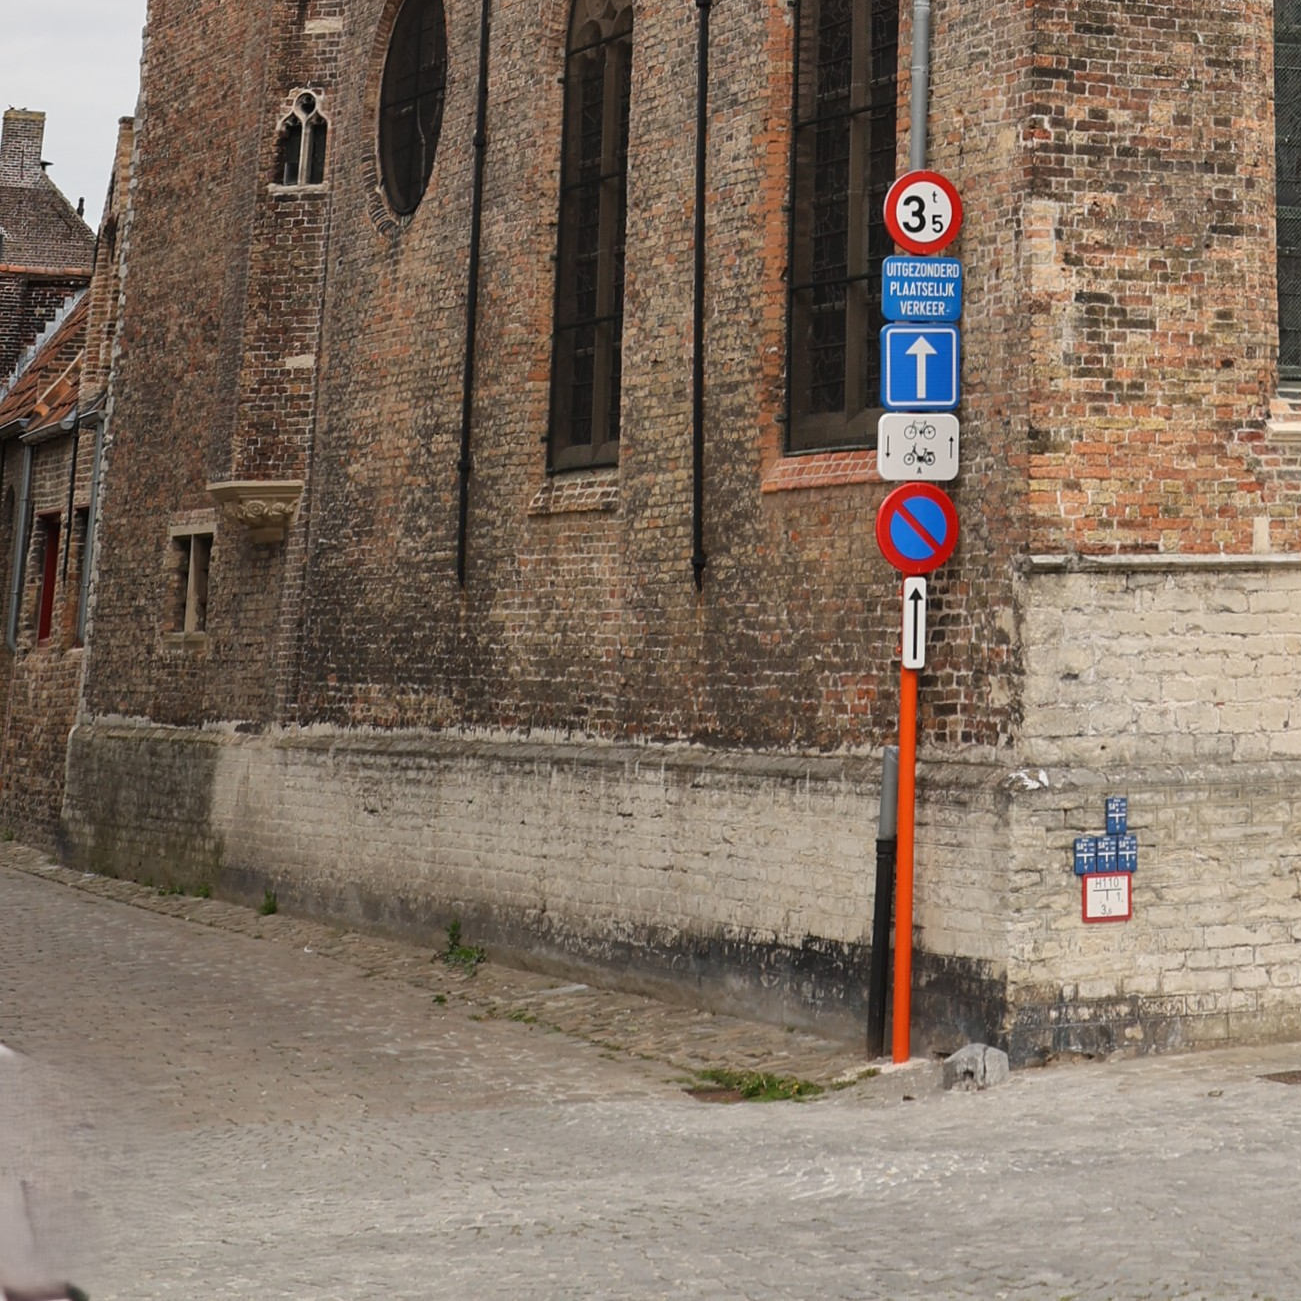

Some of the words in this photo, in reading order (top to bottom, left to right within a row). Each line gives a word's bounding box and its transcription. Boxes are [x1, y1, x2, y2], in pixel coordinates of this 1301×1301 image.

[932, 191, 937, 203] t
[886, 262, 959, 278] UITGEZONDERD
[889, 281, 955, 297] PLAATSELIJK
[900, 301, 946, 316] VERKEER
[1095, 877, 1120, 889] H110
